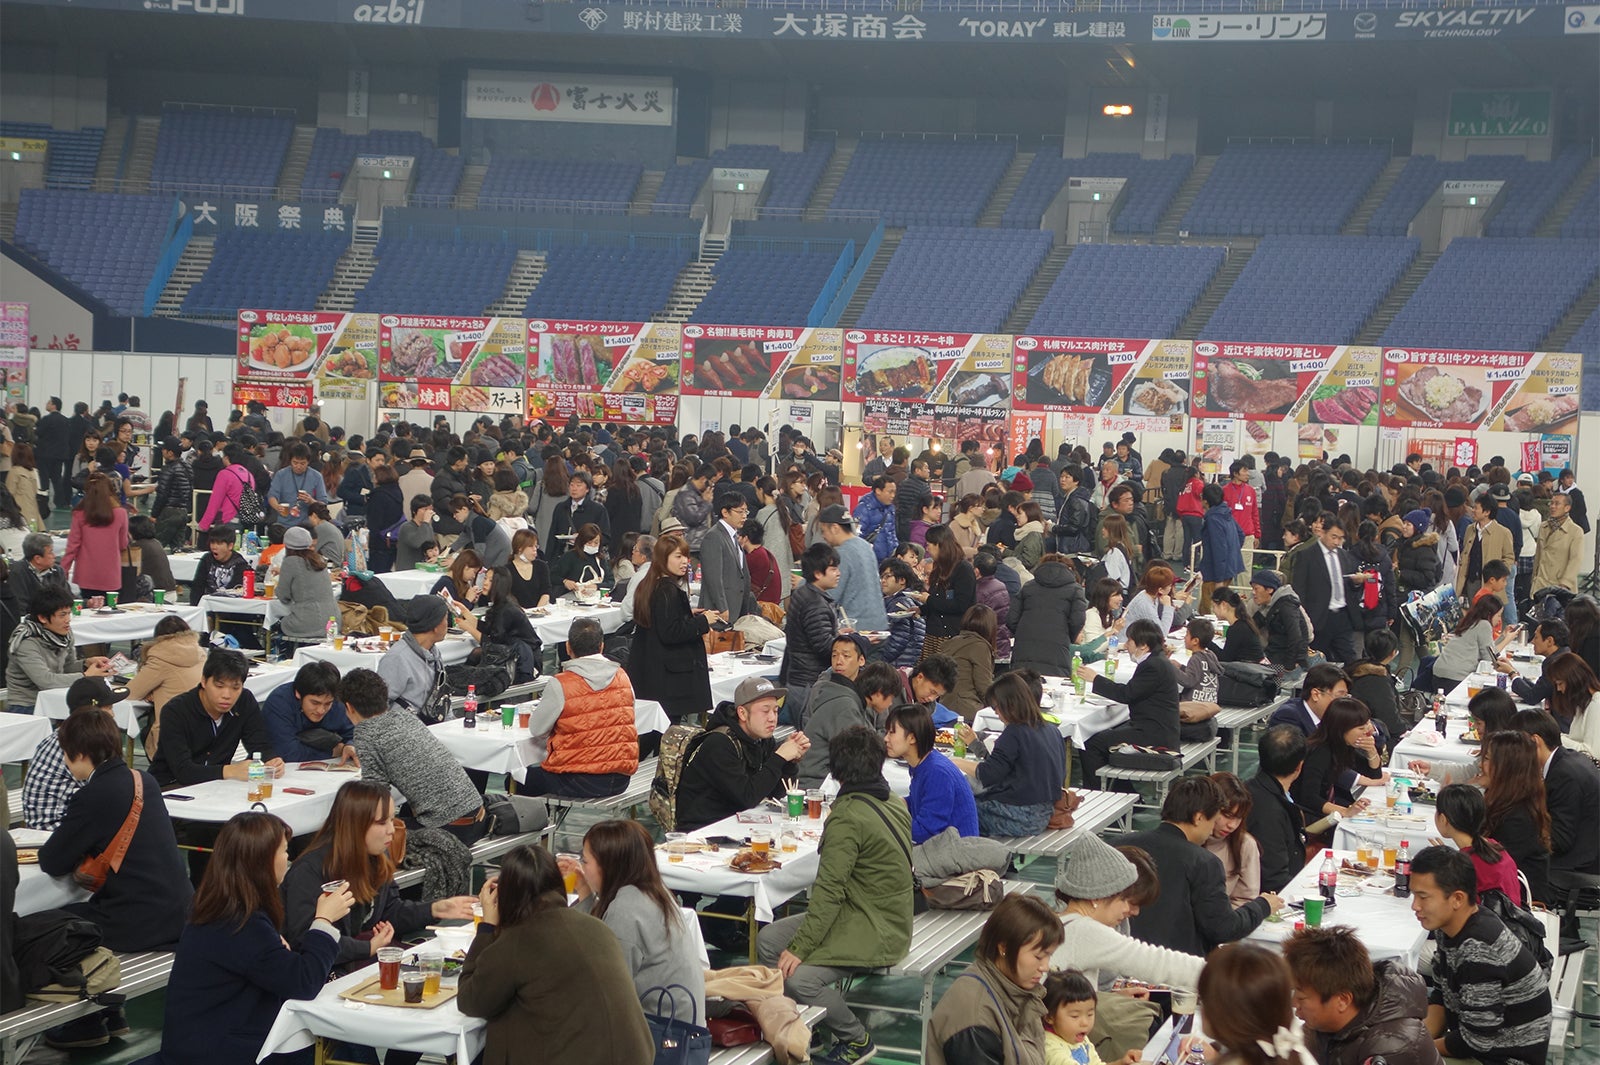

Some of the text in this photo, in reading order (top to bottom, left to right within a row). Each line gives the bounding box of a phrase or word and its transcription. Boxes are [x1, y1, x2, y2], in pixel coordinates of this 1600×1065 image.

[353, 0, 425, 25] azbil
[1394, 8, 1535, 27] SKYACTIV
[623, 10, 743, 32] 野村建設工業
[773, 13, 927, 39] 大塚商会
[1153, 16, 1172, 27] SEA
[1053, 22, 1126, 38] 東レ建設
[1172, 28, 1191, 38] LINK
[1423, 28, 1501, 38] TECHNOLOGY
[565, 86, 664, 113] 富士火災
[1454, 117, 1547, 135] PALAZZO
[193, 201, 346, 232] 大阪祭典
[265, 311, 318, 323] 骨なしからあげ
[554, 323, 630, 335] 牛サーロイン カツレツ
[766, 329, 794, 340] 肉寿司
[605, 337, 632, 346] ¥1,400
[847, 334, 866, 342] MR-4
[765, 343, 793, 351] ¥1,400
[1042, 340, 1126, 353] 札幌マルエス肉汁餃子
[1197, 346, 1218, 354] MR-2
[1223, 345, 1322, 360] 近江牛豪快切り落とし
[932, 350, 961, 358] ¥1,400
[1109, 353, 1133, 363] ¥700
[1387, 353, 1408, 361] MR-1
[1291, 361, 1324, 370] ¥1,400
[1486, 369, 1521, 379] ¥1,400
[419, 389, 449, 407] 焼肉
[492, 392, 522, 410] ステーキ
[1101, 417, 1146, 432] 神のラー油
